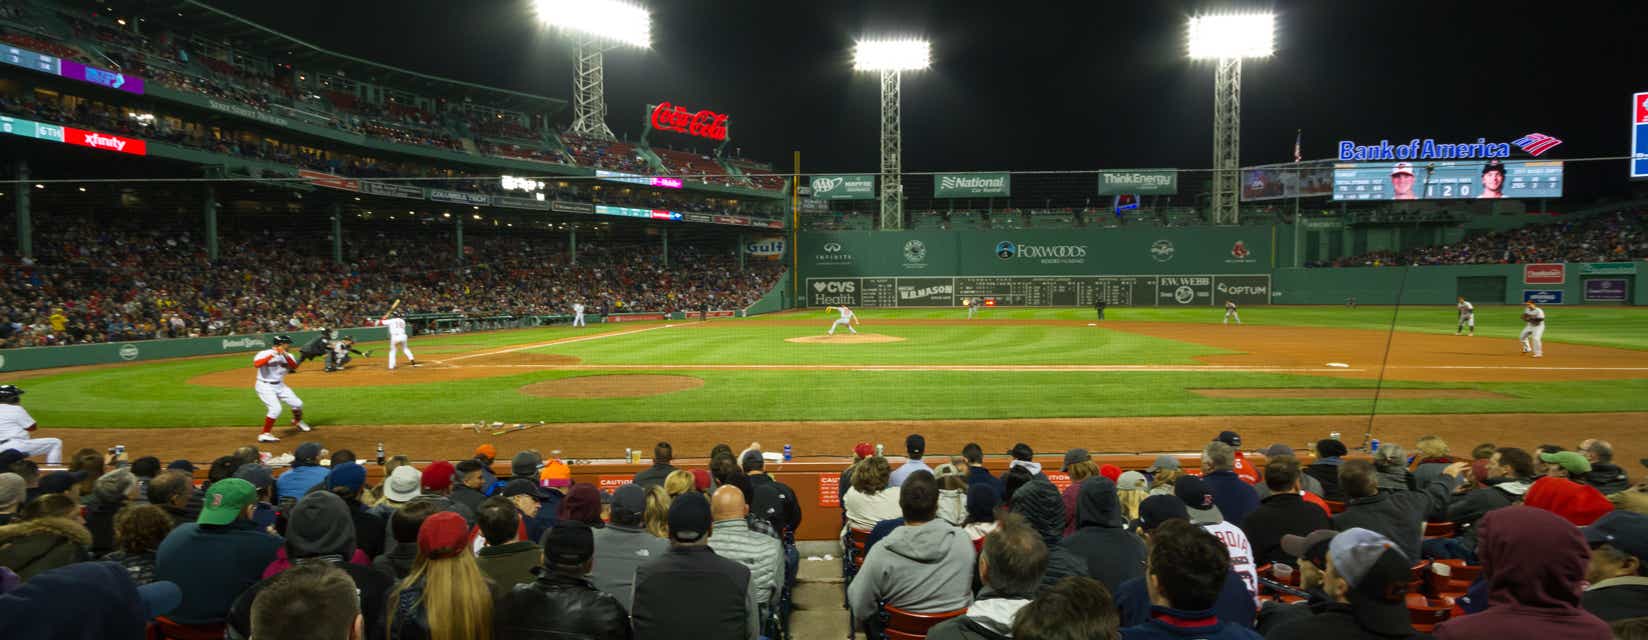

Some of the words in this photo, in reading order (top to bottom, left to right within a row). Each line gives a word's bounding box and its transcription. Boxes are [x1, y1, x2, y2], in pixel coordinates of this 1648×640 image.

[84, 133, 126, 151] xfinity
[1339, 140, 1394, 160] Bank
[1396, 139, 1420, 159] of
[1422, 138, 1510, 159] America
[955, 177, 1005, 188] National
[1443, 185, 1454, 197] 2
[1460, 185, 1470, 196] 0
[749, 240, 783, 253] Gulf
[827, 281, 855, 293] CVS
[1180, 278, 1210, 286] WEBB
[1228, 286, 1266, 295] OPTUM
[815, 293, 856, 305] Health
